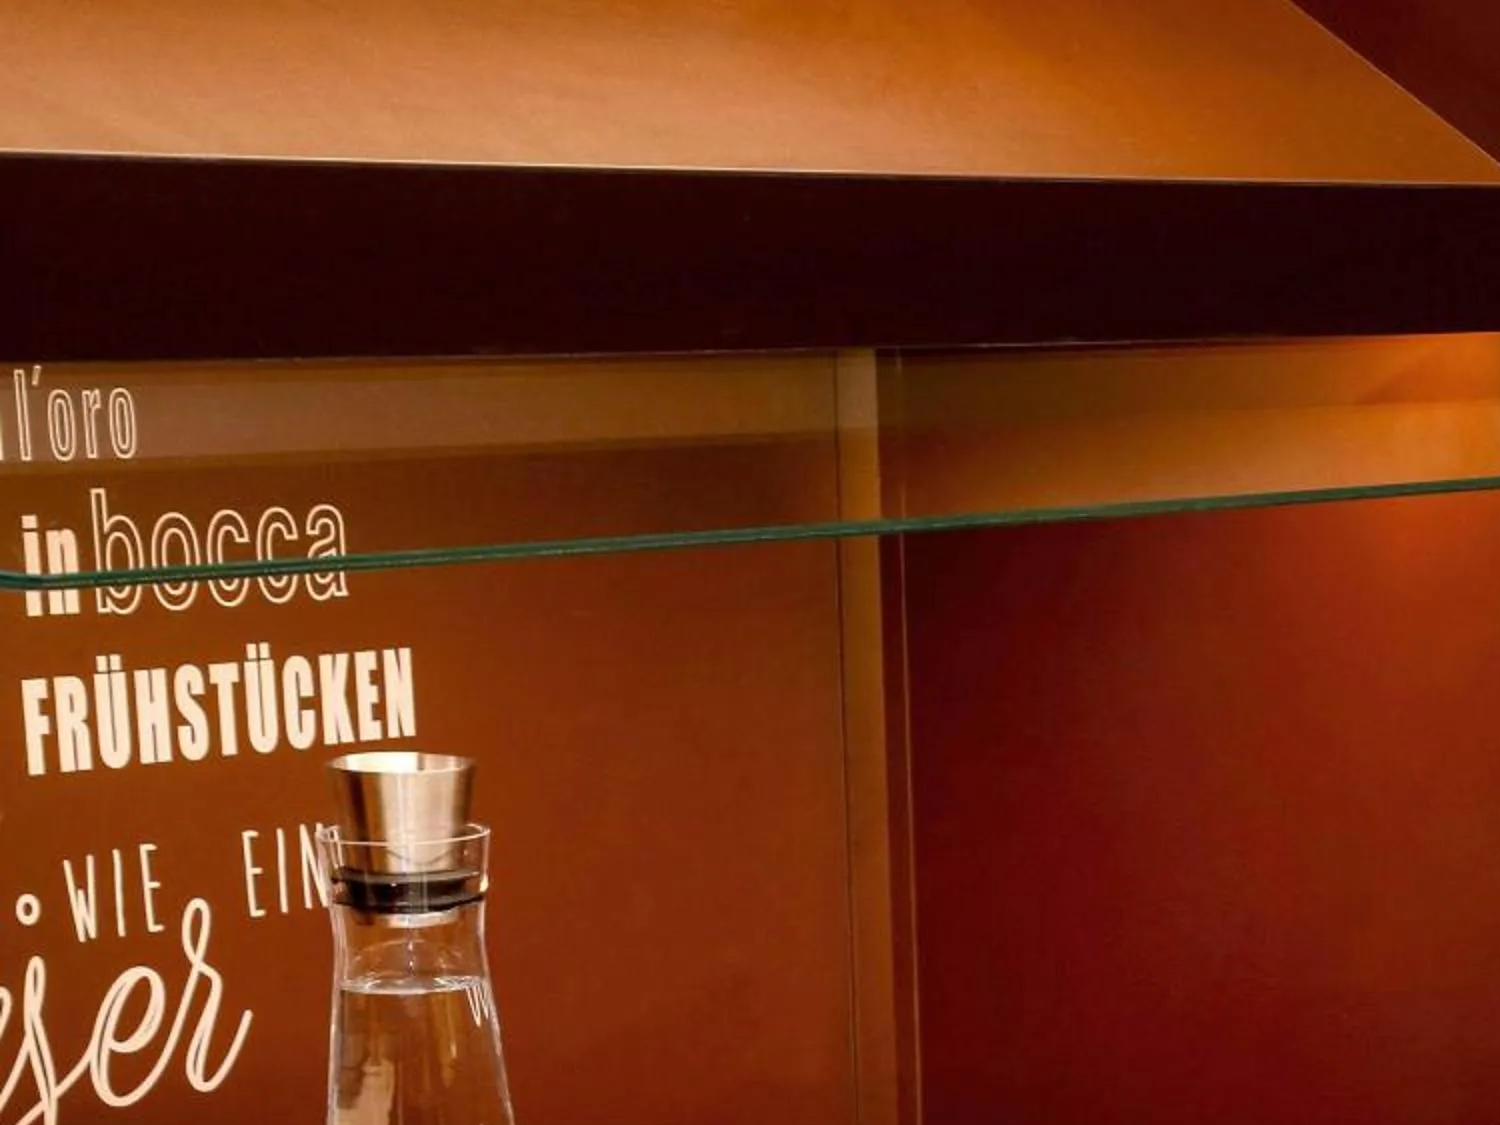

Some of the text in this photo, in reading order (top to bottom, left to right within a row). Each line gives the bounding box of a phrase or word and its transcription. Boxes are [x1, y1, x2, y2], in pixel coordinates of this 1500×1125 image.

[13, 365, 138, 461] l'oro
[20, 488, 350, 617] in bocca
[21, 642, 417, 776] FRÜHSTÜCKEN
[63, 843, 166, 944] WIE
